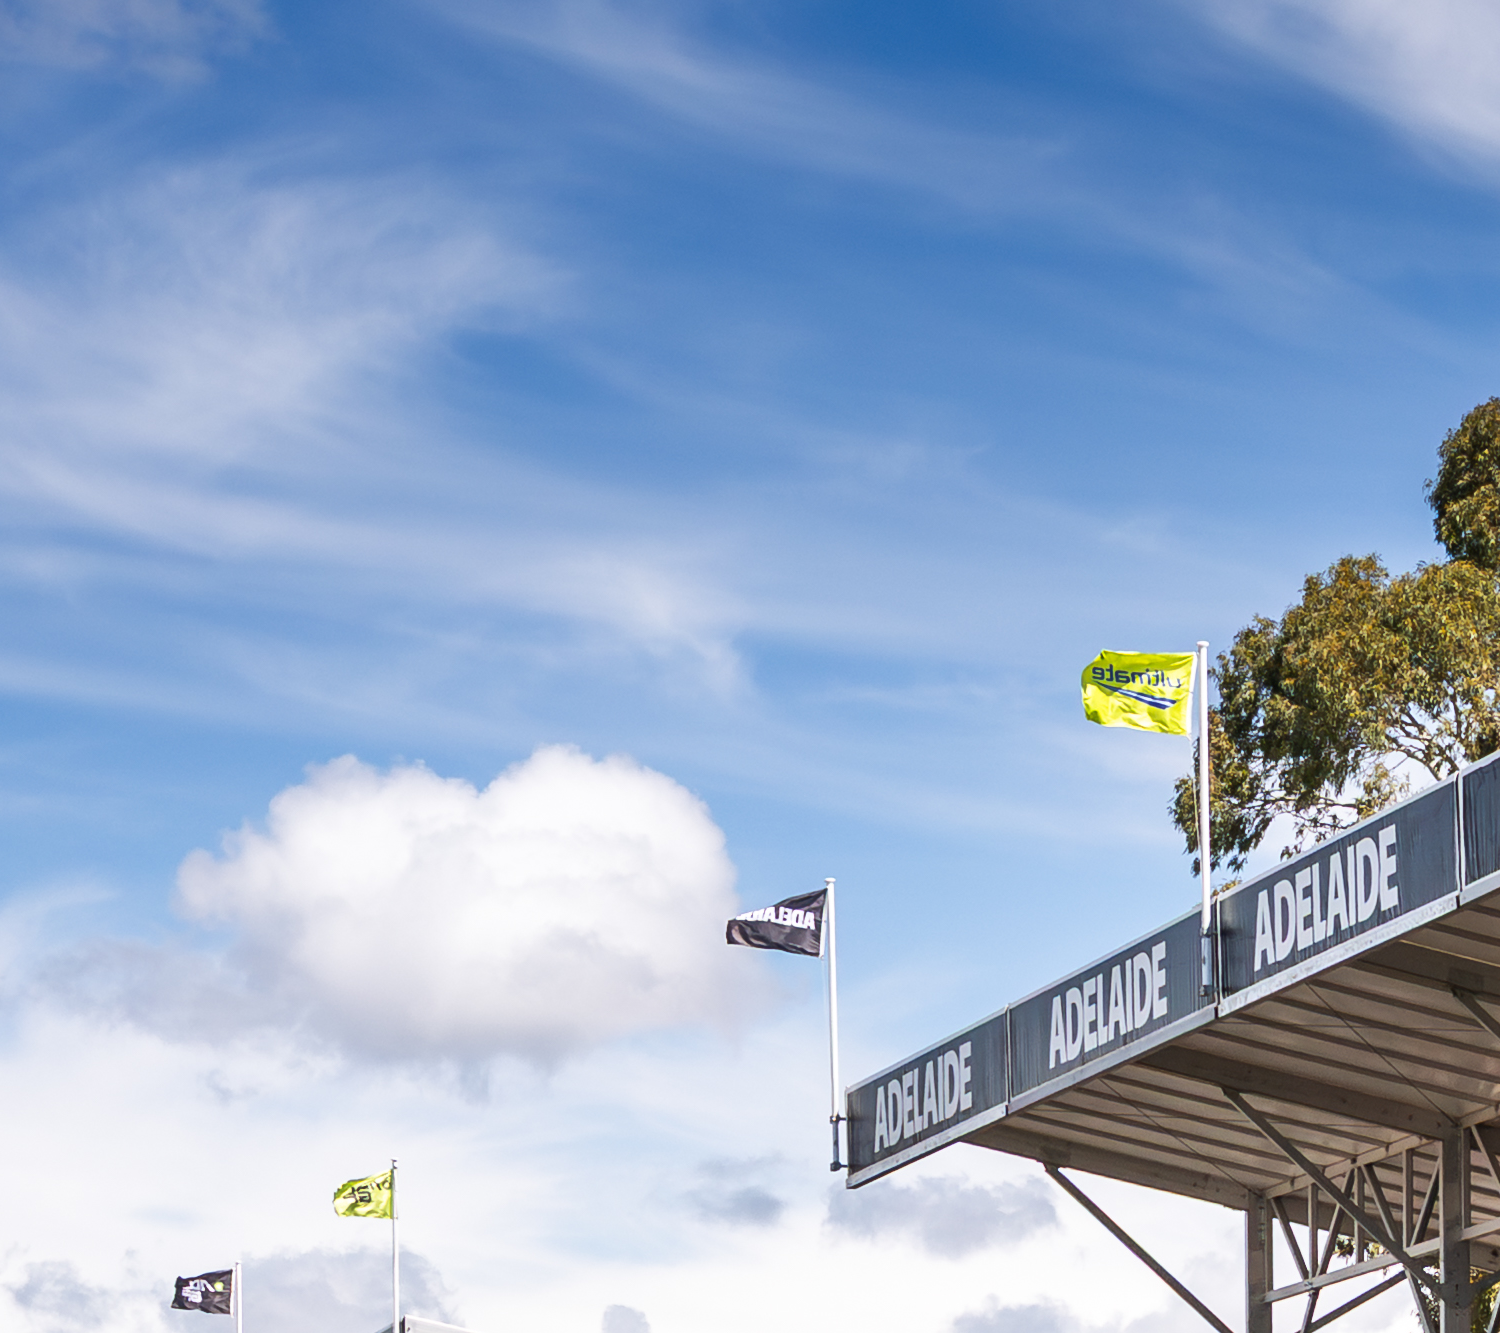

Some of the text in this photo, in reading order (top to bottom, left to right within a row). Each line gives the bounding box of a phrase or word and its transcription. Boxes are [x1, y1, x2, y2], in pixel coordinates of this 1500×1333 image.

[1254, 825, 1398, 972] ADELAIDE
[1048, 940, 1167, 1071] ADELAIDE
[873, 1041, 974, 1155] ADELAIDE
